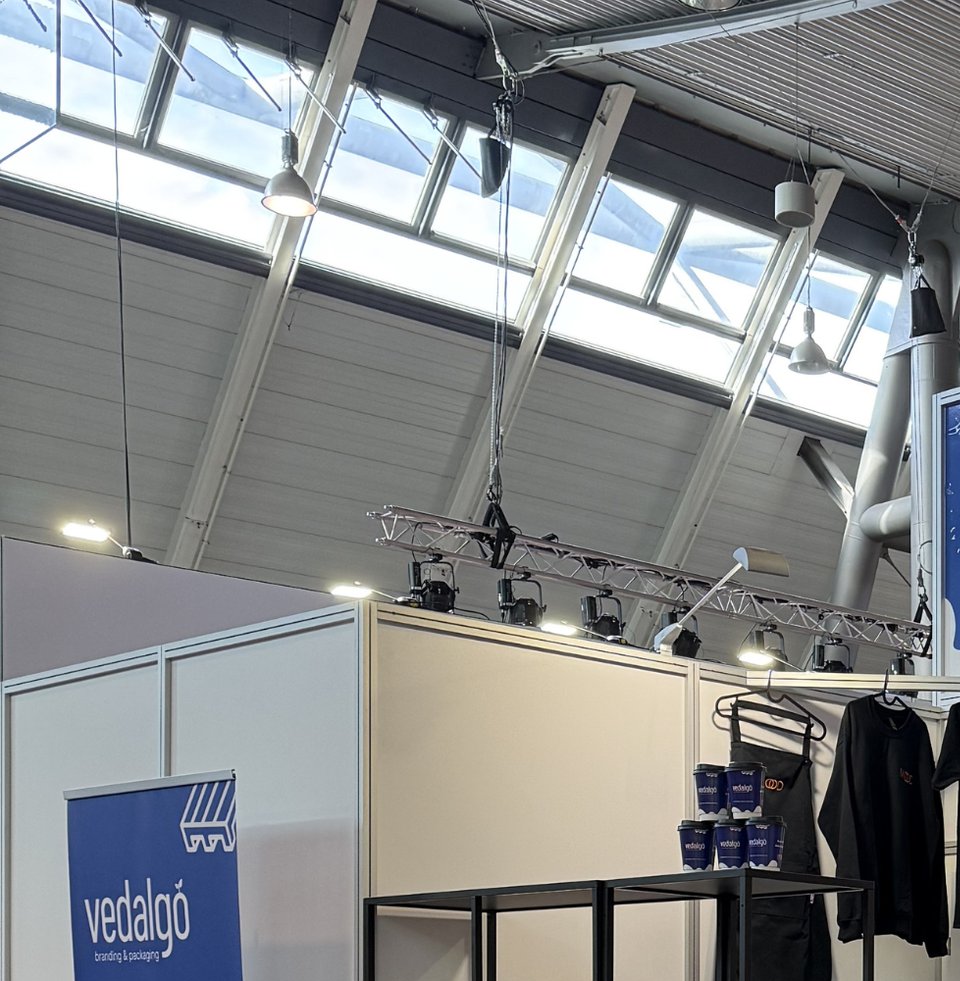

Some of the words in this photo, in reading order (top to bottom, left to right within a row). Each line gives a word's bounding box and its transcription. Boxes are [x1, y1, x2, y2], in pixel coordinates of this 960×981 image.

[95, 950, 122, 963] branding
[123, 949, 128, 961] &
[129, 950, 160, 963] packaging
